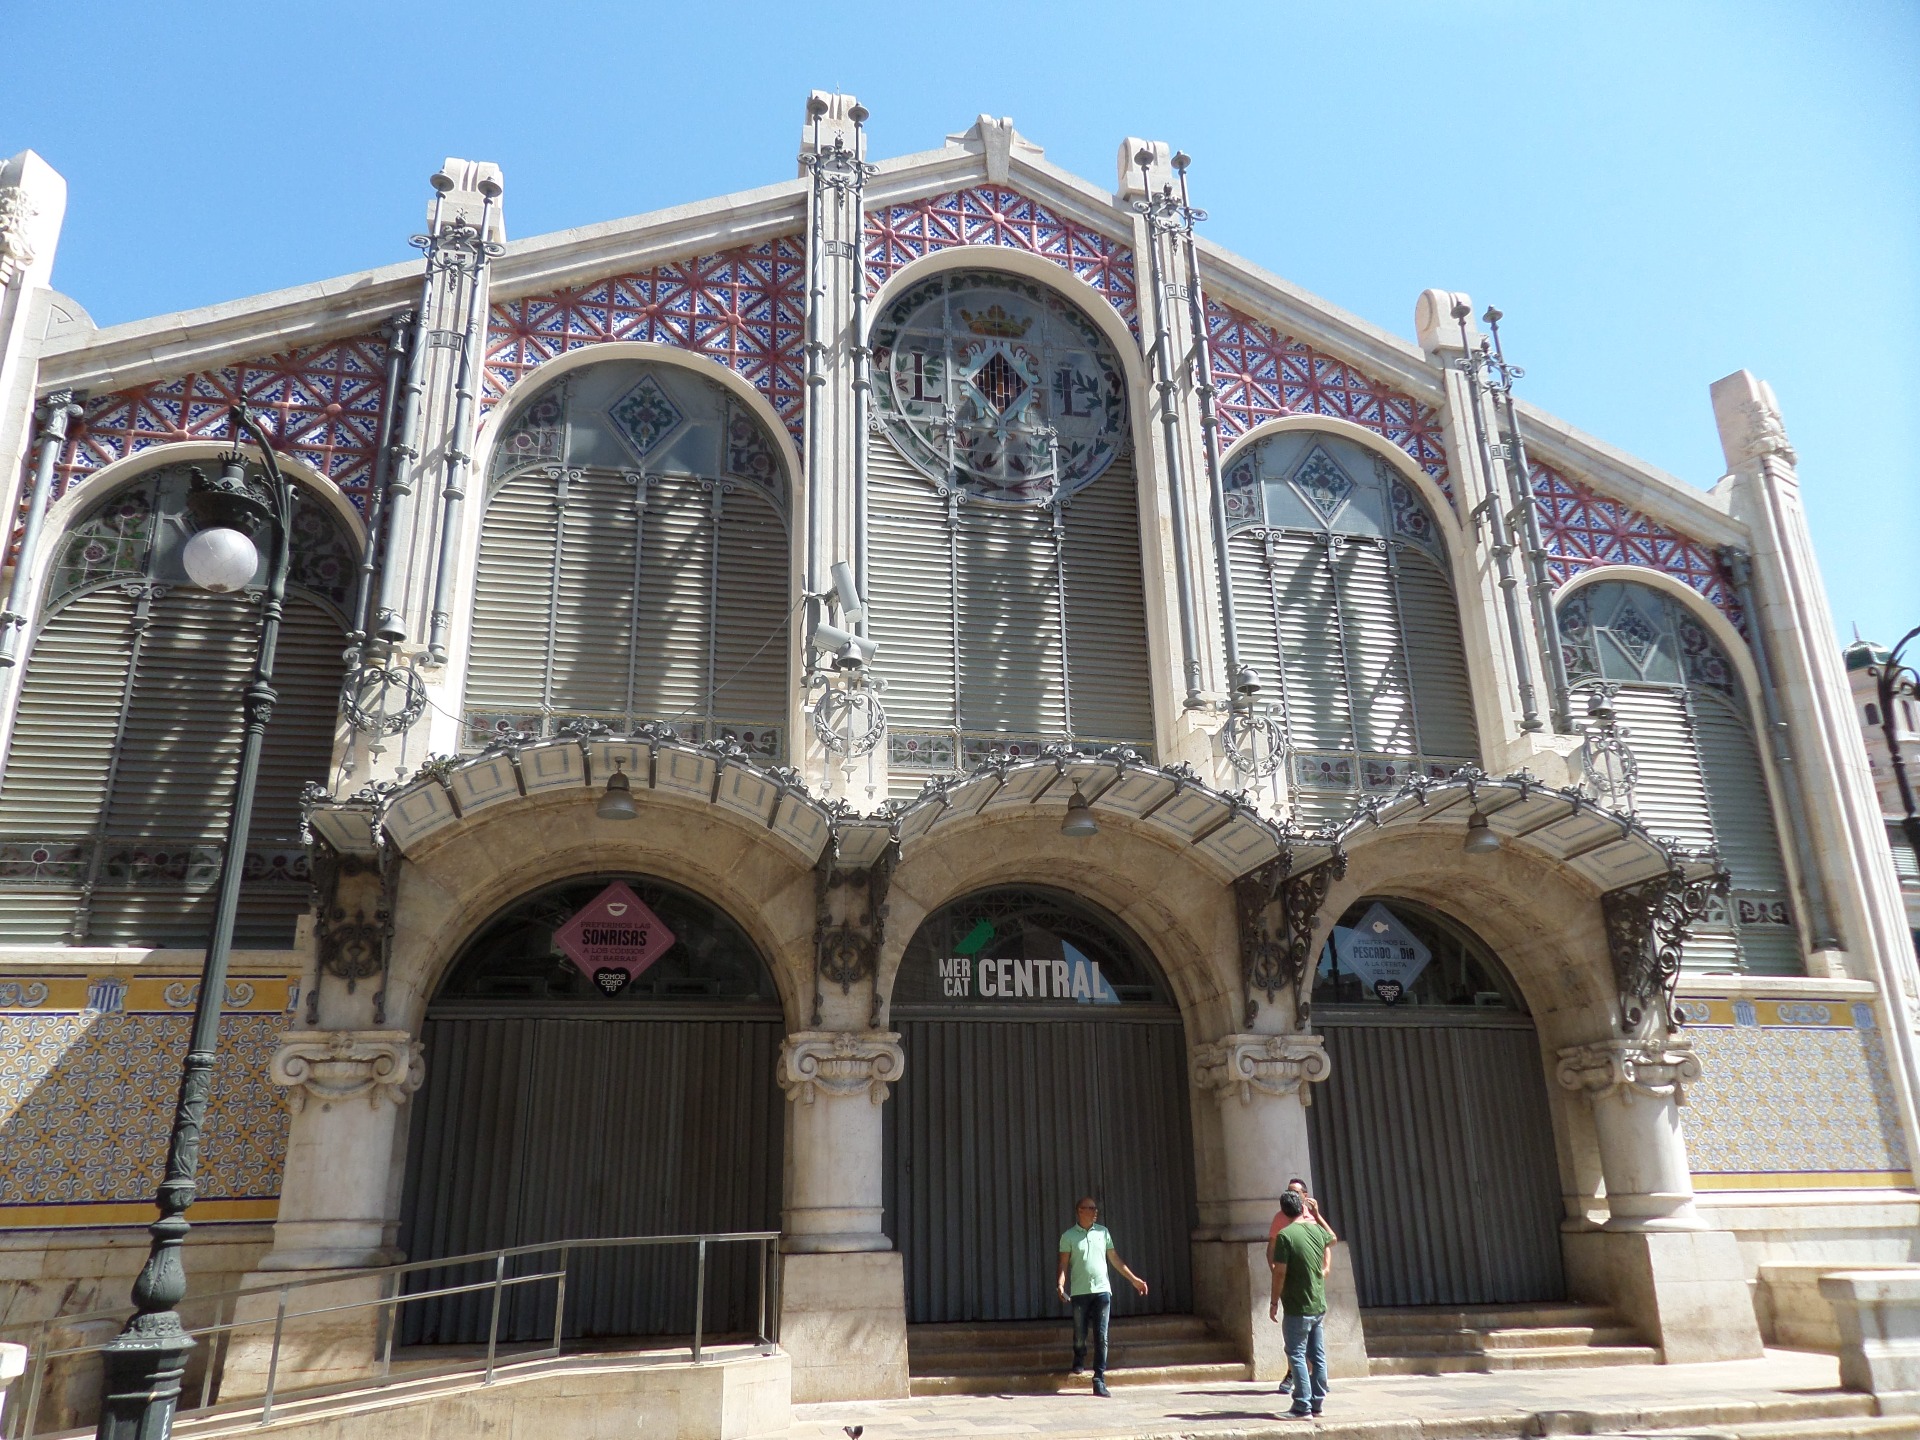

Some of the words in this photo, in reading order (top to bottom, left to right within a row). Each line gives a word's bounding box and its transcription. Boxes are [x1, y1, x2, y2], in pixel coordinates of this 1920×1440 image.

[582, 929, 647, 946] SONRISAS
[1353, 946, 1391, 959] PESCADO
[939, 959, 970, 977] MER
[944, 978, 970, 996] CAT
[979, 959, 1108, 998] CENTRAL
